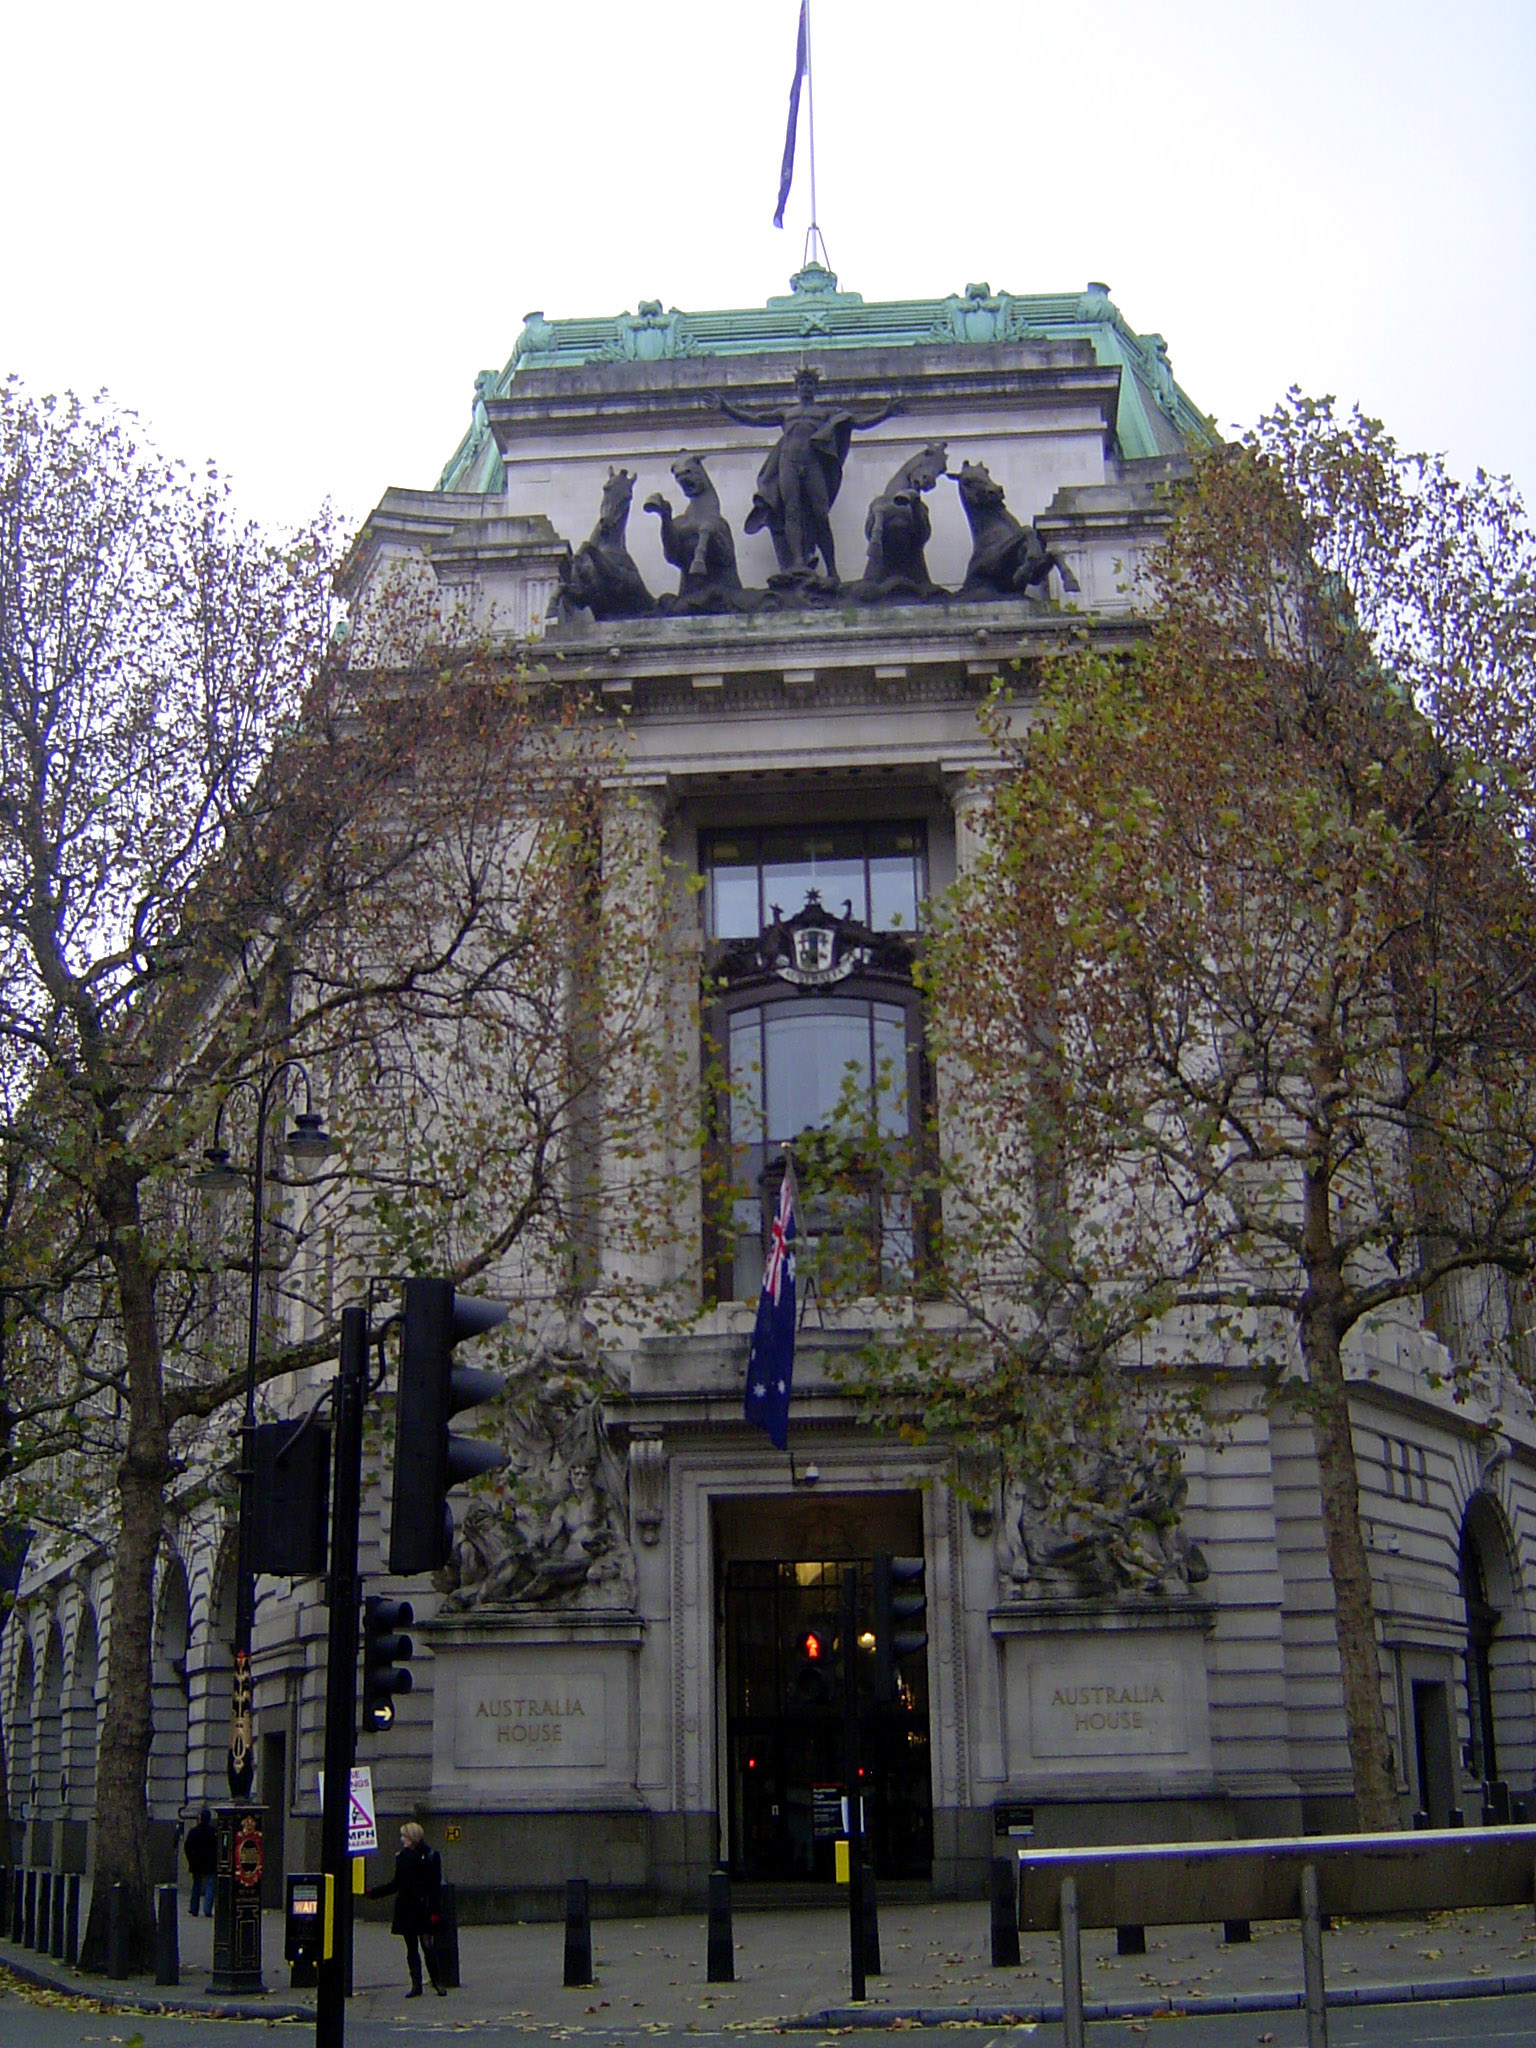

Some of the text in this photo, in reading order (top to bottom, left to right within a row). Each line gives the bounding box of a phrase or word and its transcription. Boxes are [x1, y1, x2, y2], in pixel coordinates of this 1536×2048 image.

[1051, 1686, 1164, 1705] AUSTRALIA
[475, 1699, 584, 1717] AUSTRALIA
[1075, 1711, 1143, 1731] HOUSE
[497, 1724, 562, 1742] HOUSE
[294, 1901, 317, 1914] WAIT
